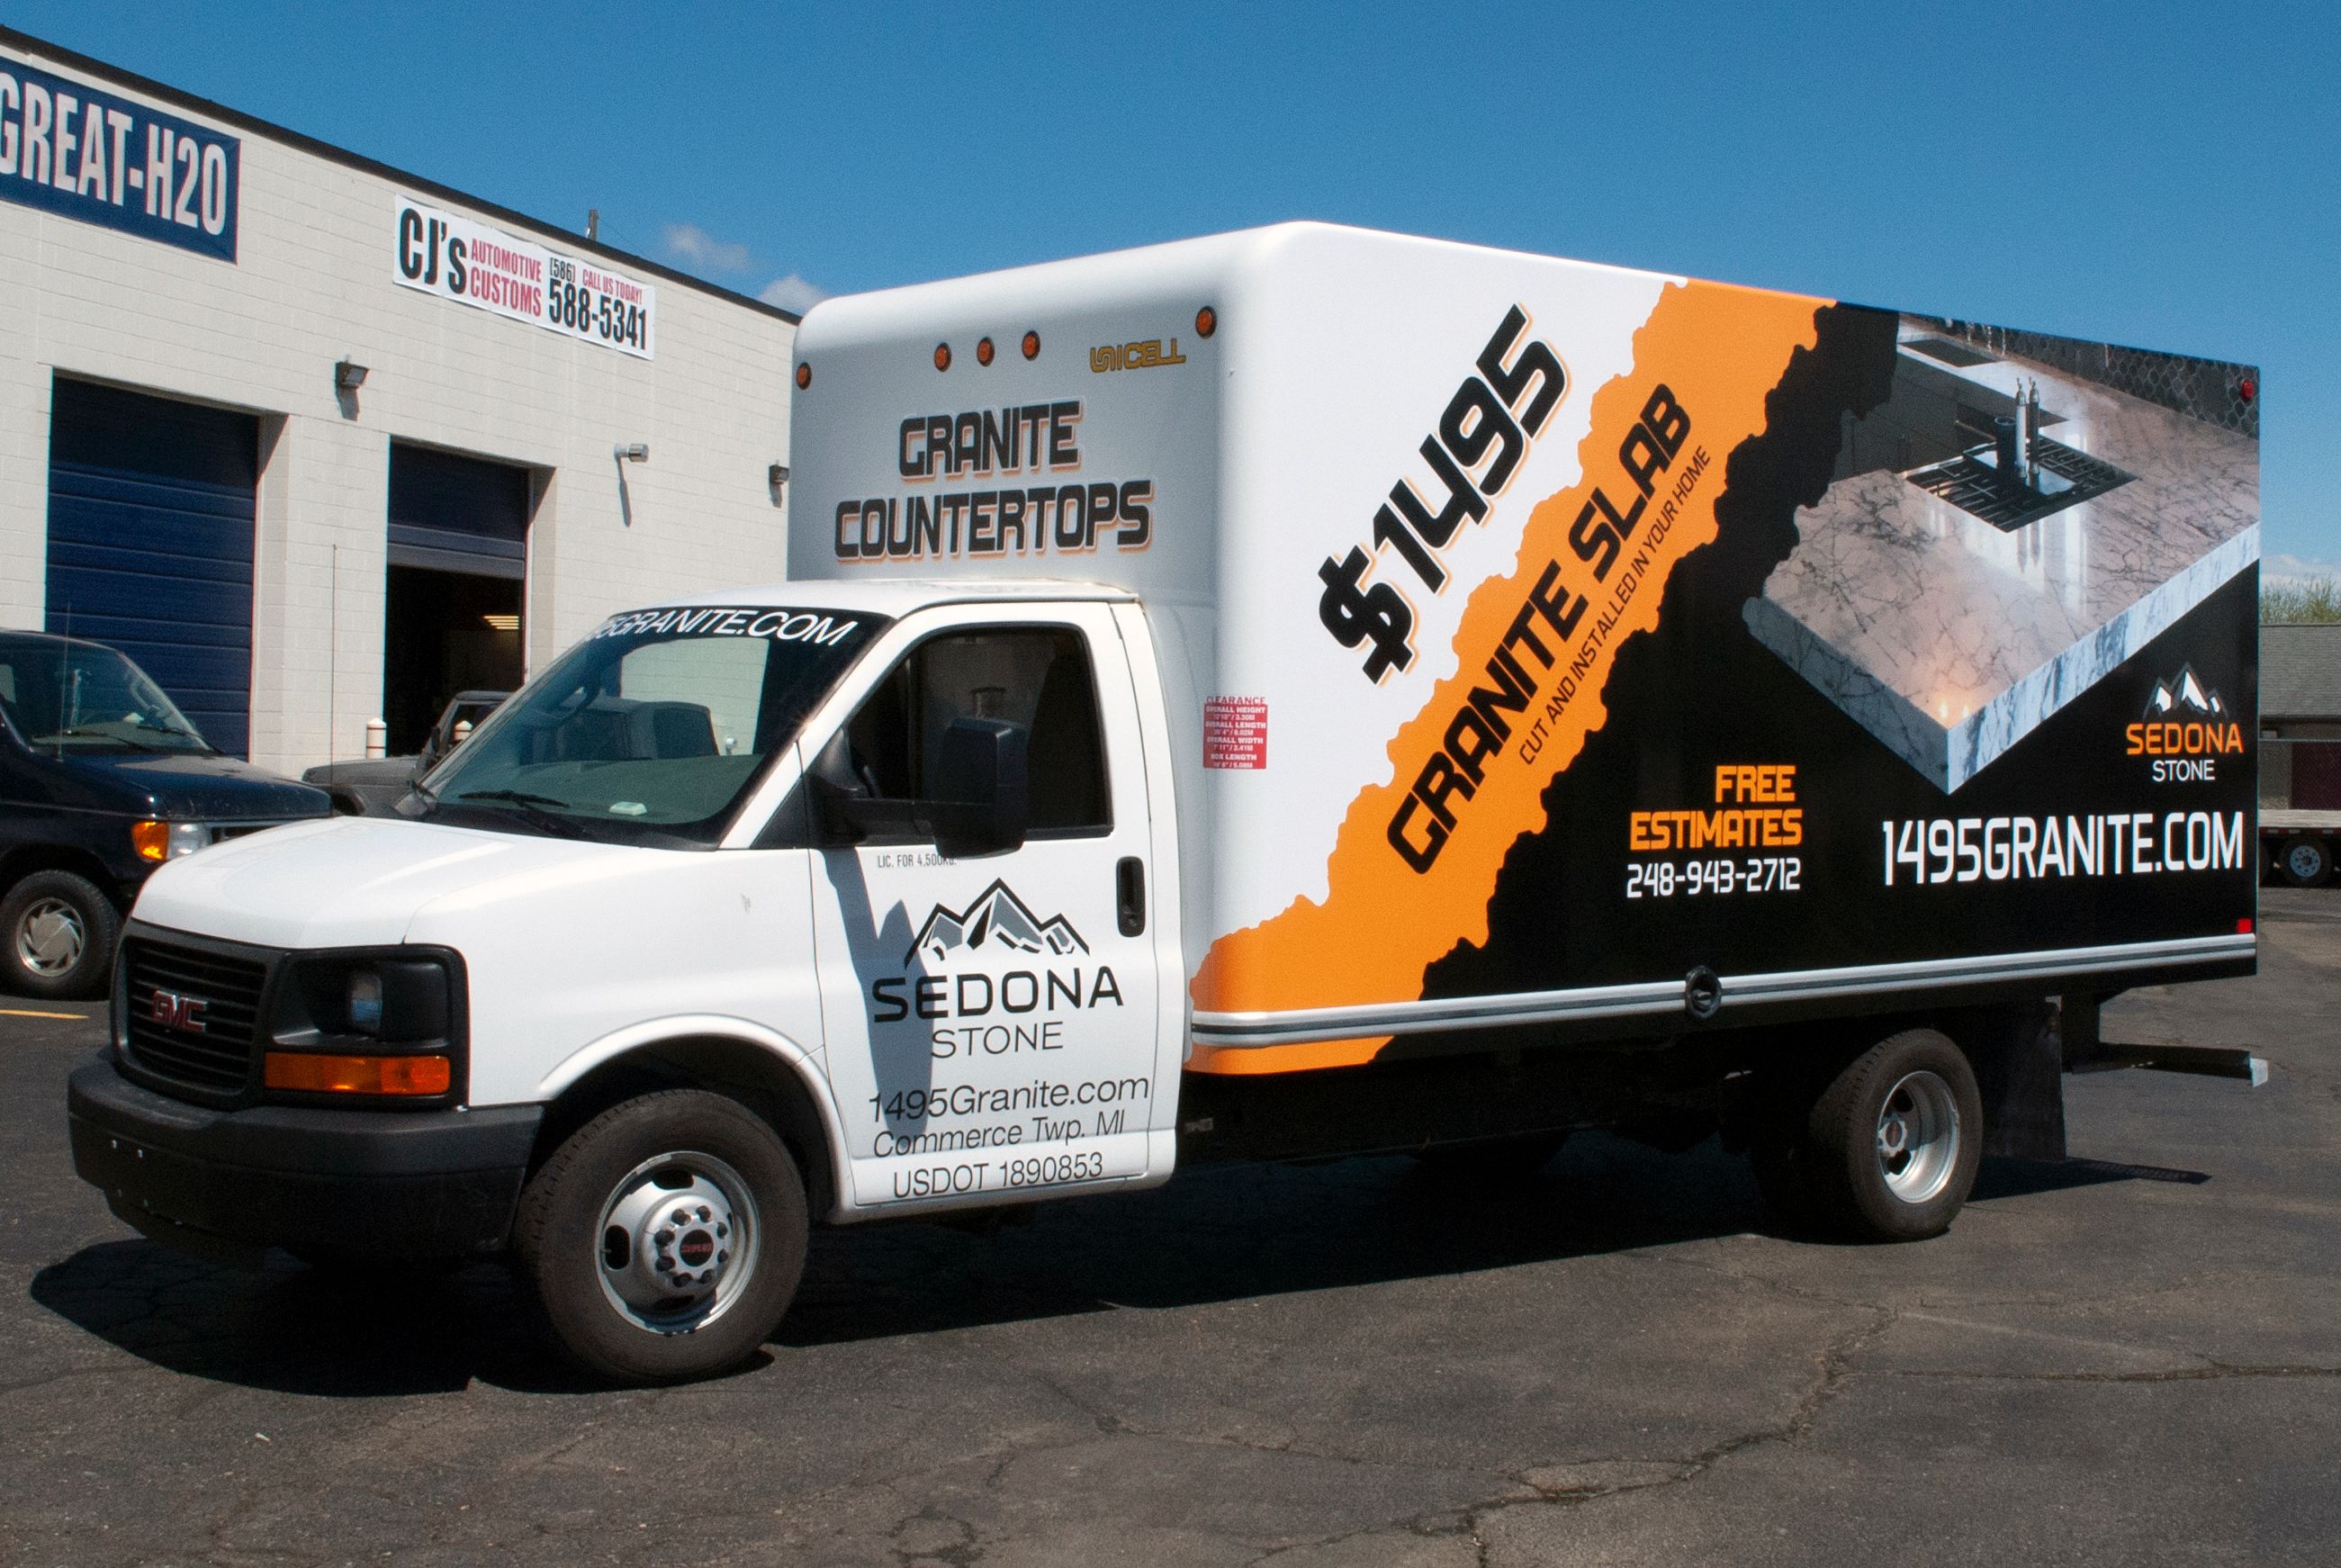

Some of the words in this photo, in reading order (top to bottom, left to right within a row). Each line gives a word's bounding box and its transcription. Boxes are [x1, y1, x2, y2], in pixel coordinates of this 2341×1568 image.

[399, 208, 467, 294] CJ's
[471, 238, 542, 283] AUTOMOTIVE
[471, 266, 542, 317] CUSTOMS
[582, 268, 601, 292] CALL
[603, 275, 615, 295] US
[615, 279, 643, 304] TODAY!
[548, 278, 646, 350] 588-5341
[899, 401, 1082, 479] GRANITE
[1319, 302, 1567, 685] $1495
[834, 480, 1153, 561] COUNTERTOPS
[1519, 718, 1551, 765] CUT
[1545, 675, 1577, 725] AND
[1569, 572, 1638, 682] INSTALLED
[1630, 549, 1651, 578] IN
[1643, 500, 1679, 556] YOUR
[1672, 445, 1711, 507] HOME
[1386, 558, 1589, 875] GRANITE
[1568, 383, 1692, 584] SLAB
[1206, 696, 1265, 705] CLEARANCE
[1235, 721, 1266, 729] LENGTH
[1237, 736, 1264, 744] WIDTH
[2126, 723, 2244, 755] SEDONA
[1715, 765, 1796, 803] FREE
[2152, 759, 2216, 782] STONE
[1630, 808, 1803, 851] ESTIMATES
[1882, 811, 2244, 887] 1495GRANITE.COM
[878, 854, 895, 869] LIC.
[897, 853, 914, 868] FOR
[1626, 857, 1801, 898] 248-943-2712
[151, 989, 209, 1033] GMC
[872, 966, 1124, 1023] SEDONA
[931, 1021, 1064, 1059] STONE
[869, 1077, 1149, 1123] 1495Granite.com
[873, 1122, 1022, 1159] Commerce
[1032, 1115, 1085, 1146] Twp.
[1095, 1108, 1124, 1135] MI
[893, 1163, 989, 1199] USDOT
[999, 1151, 1103, 1187] 1890853
